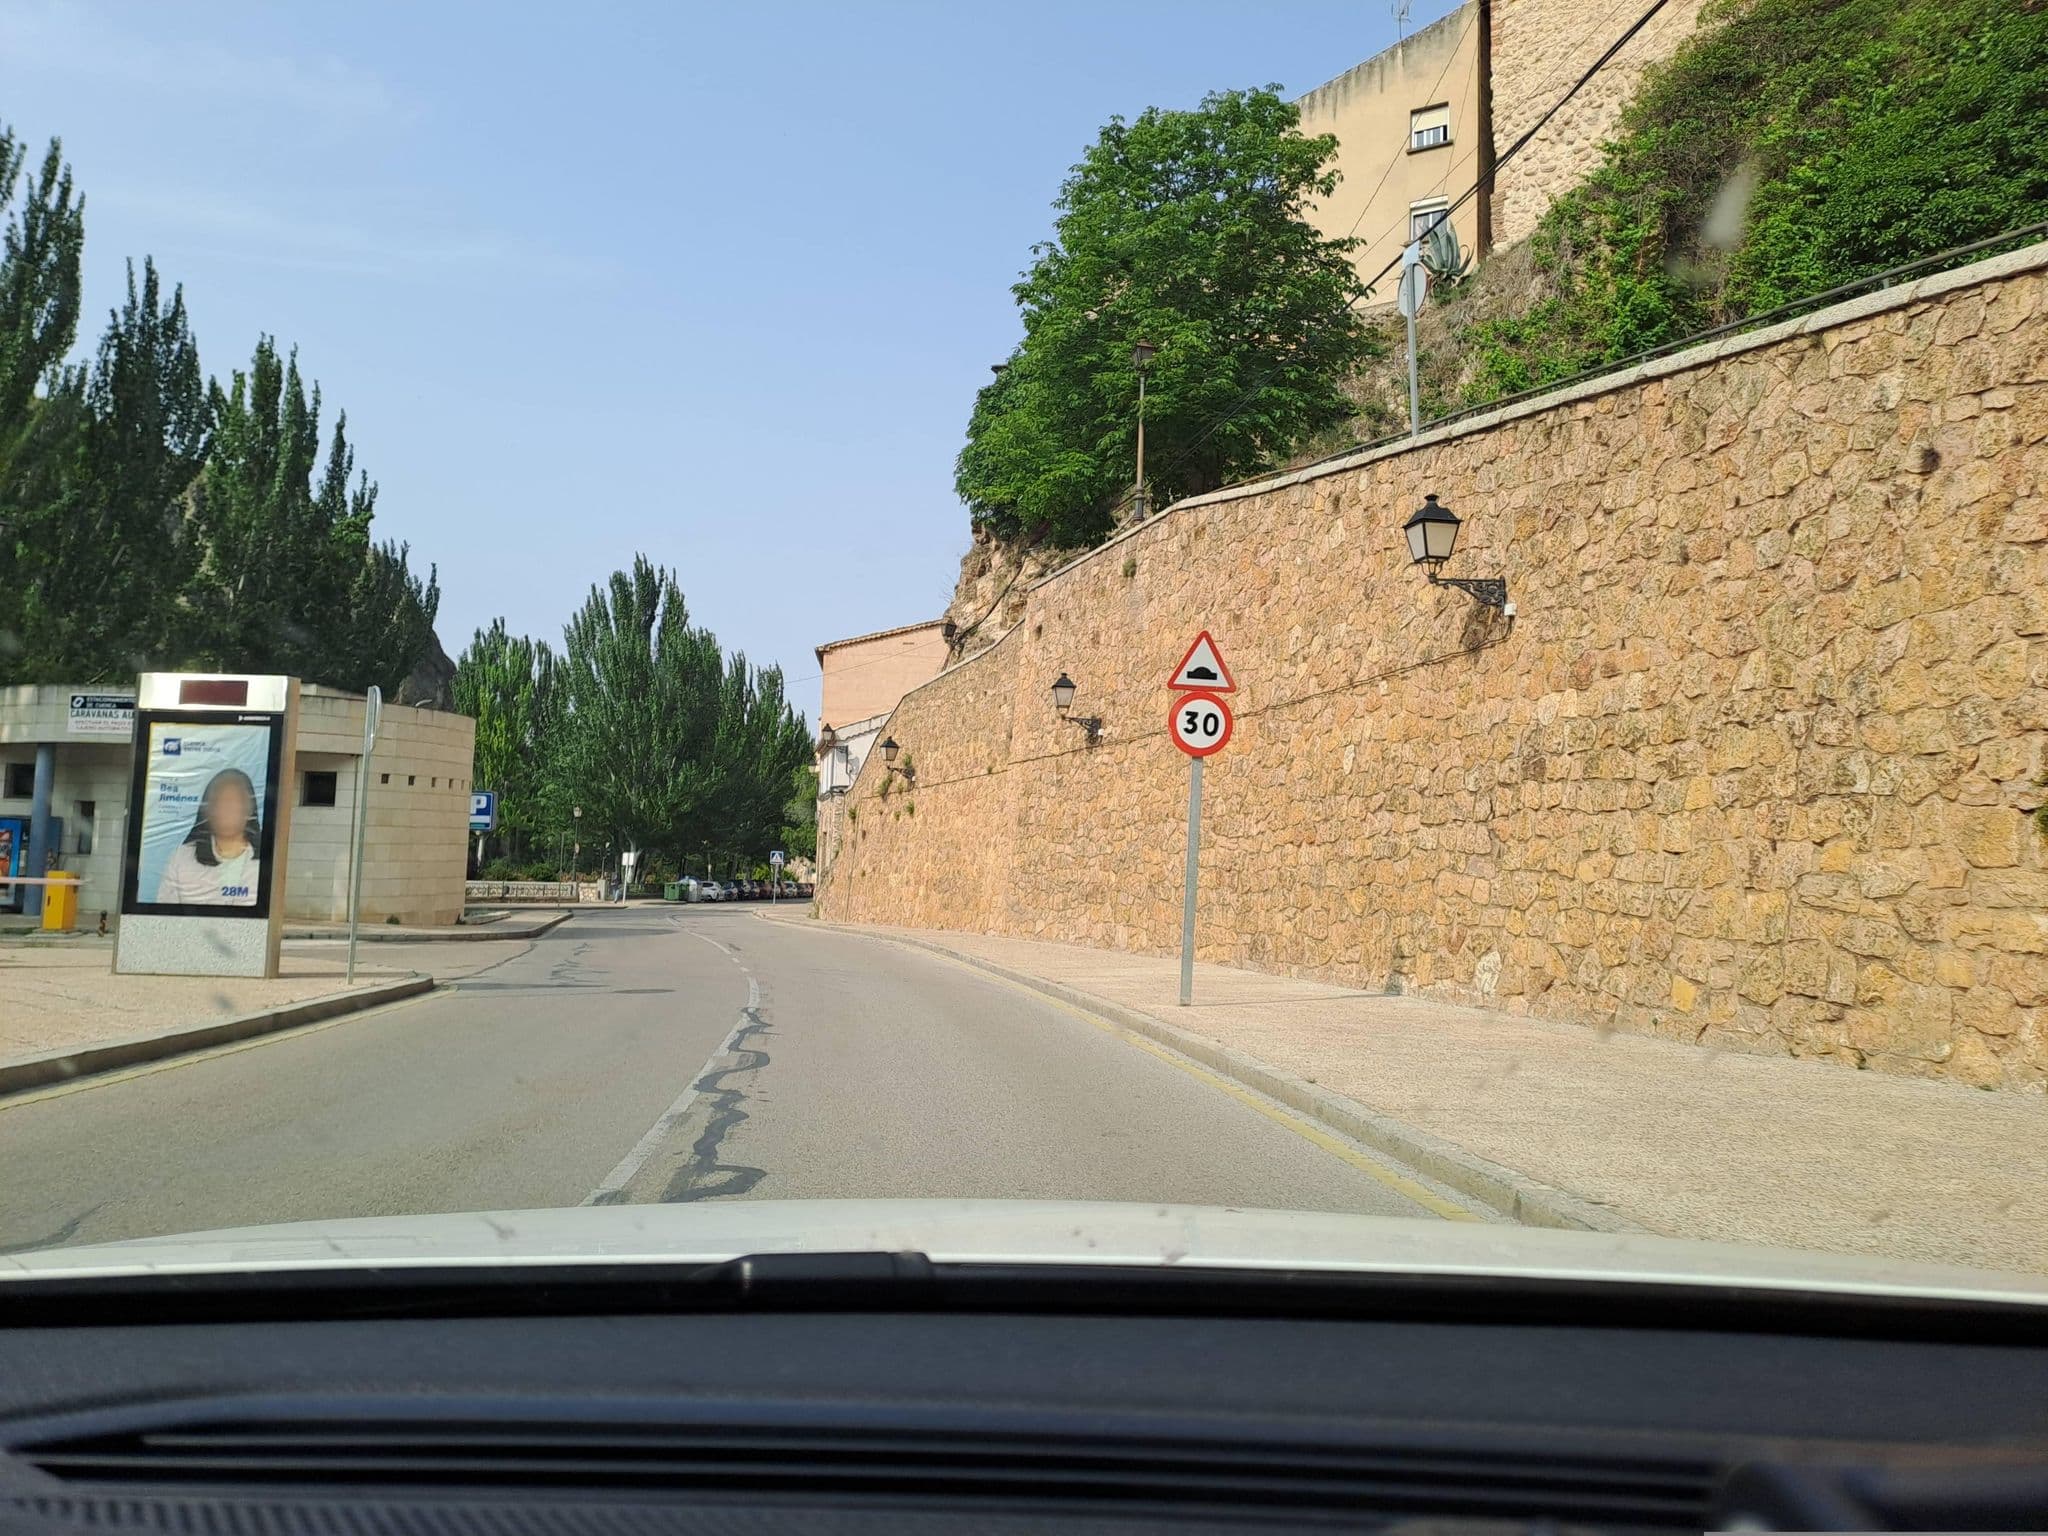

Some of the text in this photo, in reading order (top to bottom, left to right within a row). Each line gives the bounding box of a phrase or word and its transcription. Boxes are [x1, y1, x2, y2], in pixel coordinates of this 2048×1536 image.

[71, 709, 119, 719] CARAVANAS
[1183, 711, 1219, 737] 30
[160, 783, 178, 792] Bea
[158, 793, 198, 801] Jiménez
[471, 795, 487, 814] P
[222, 886, 249, 897] 28M
